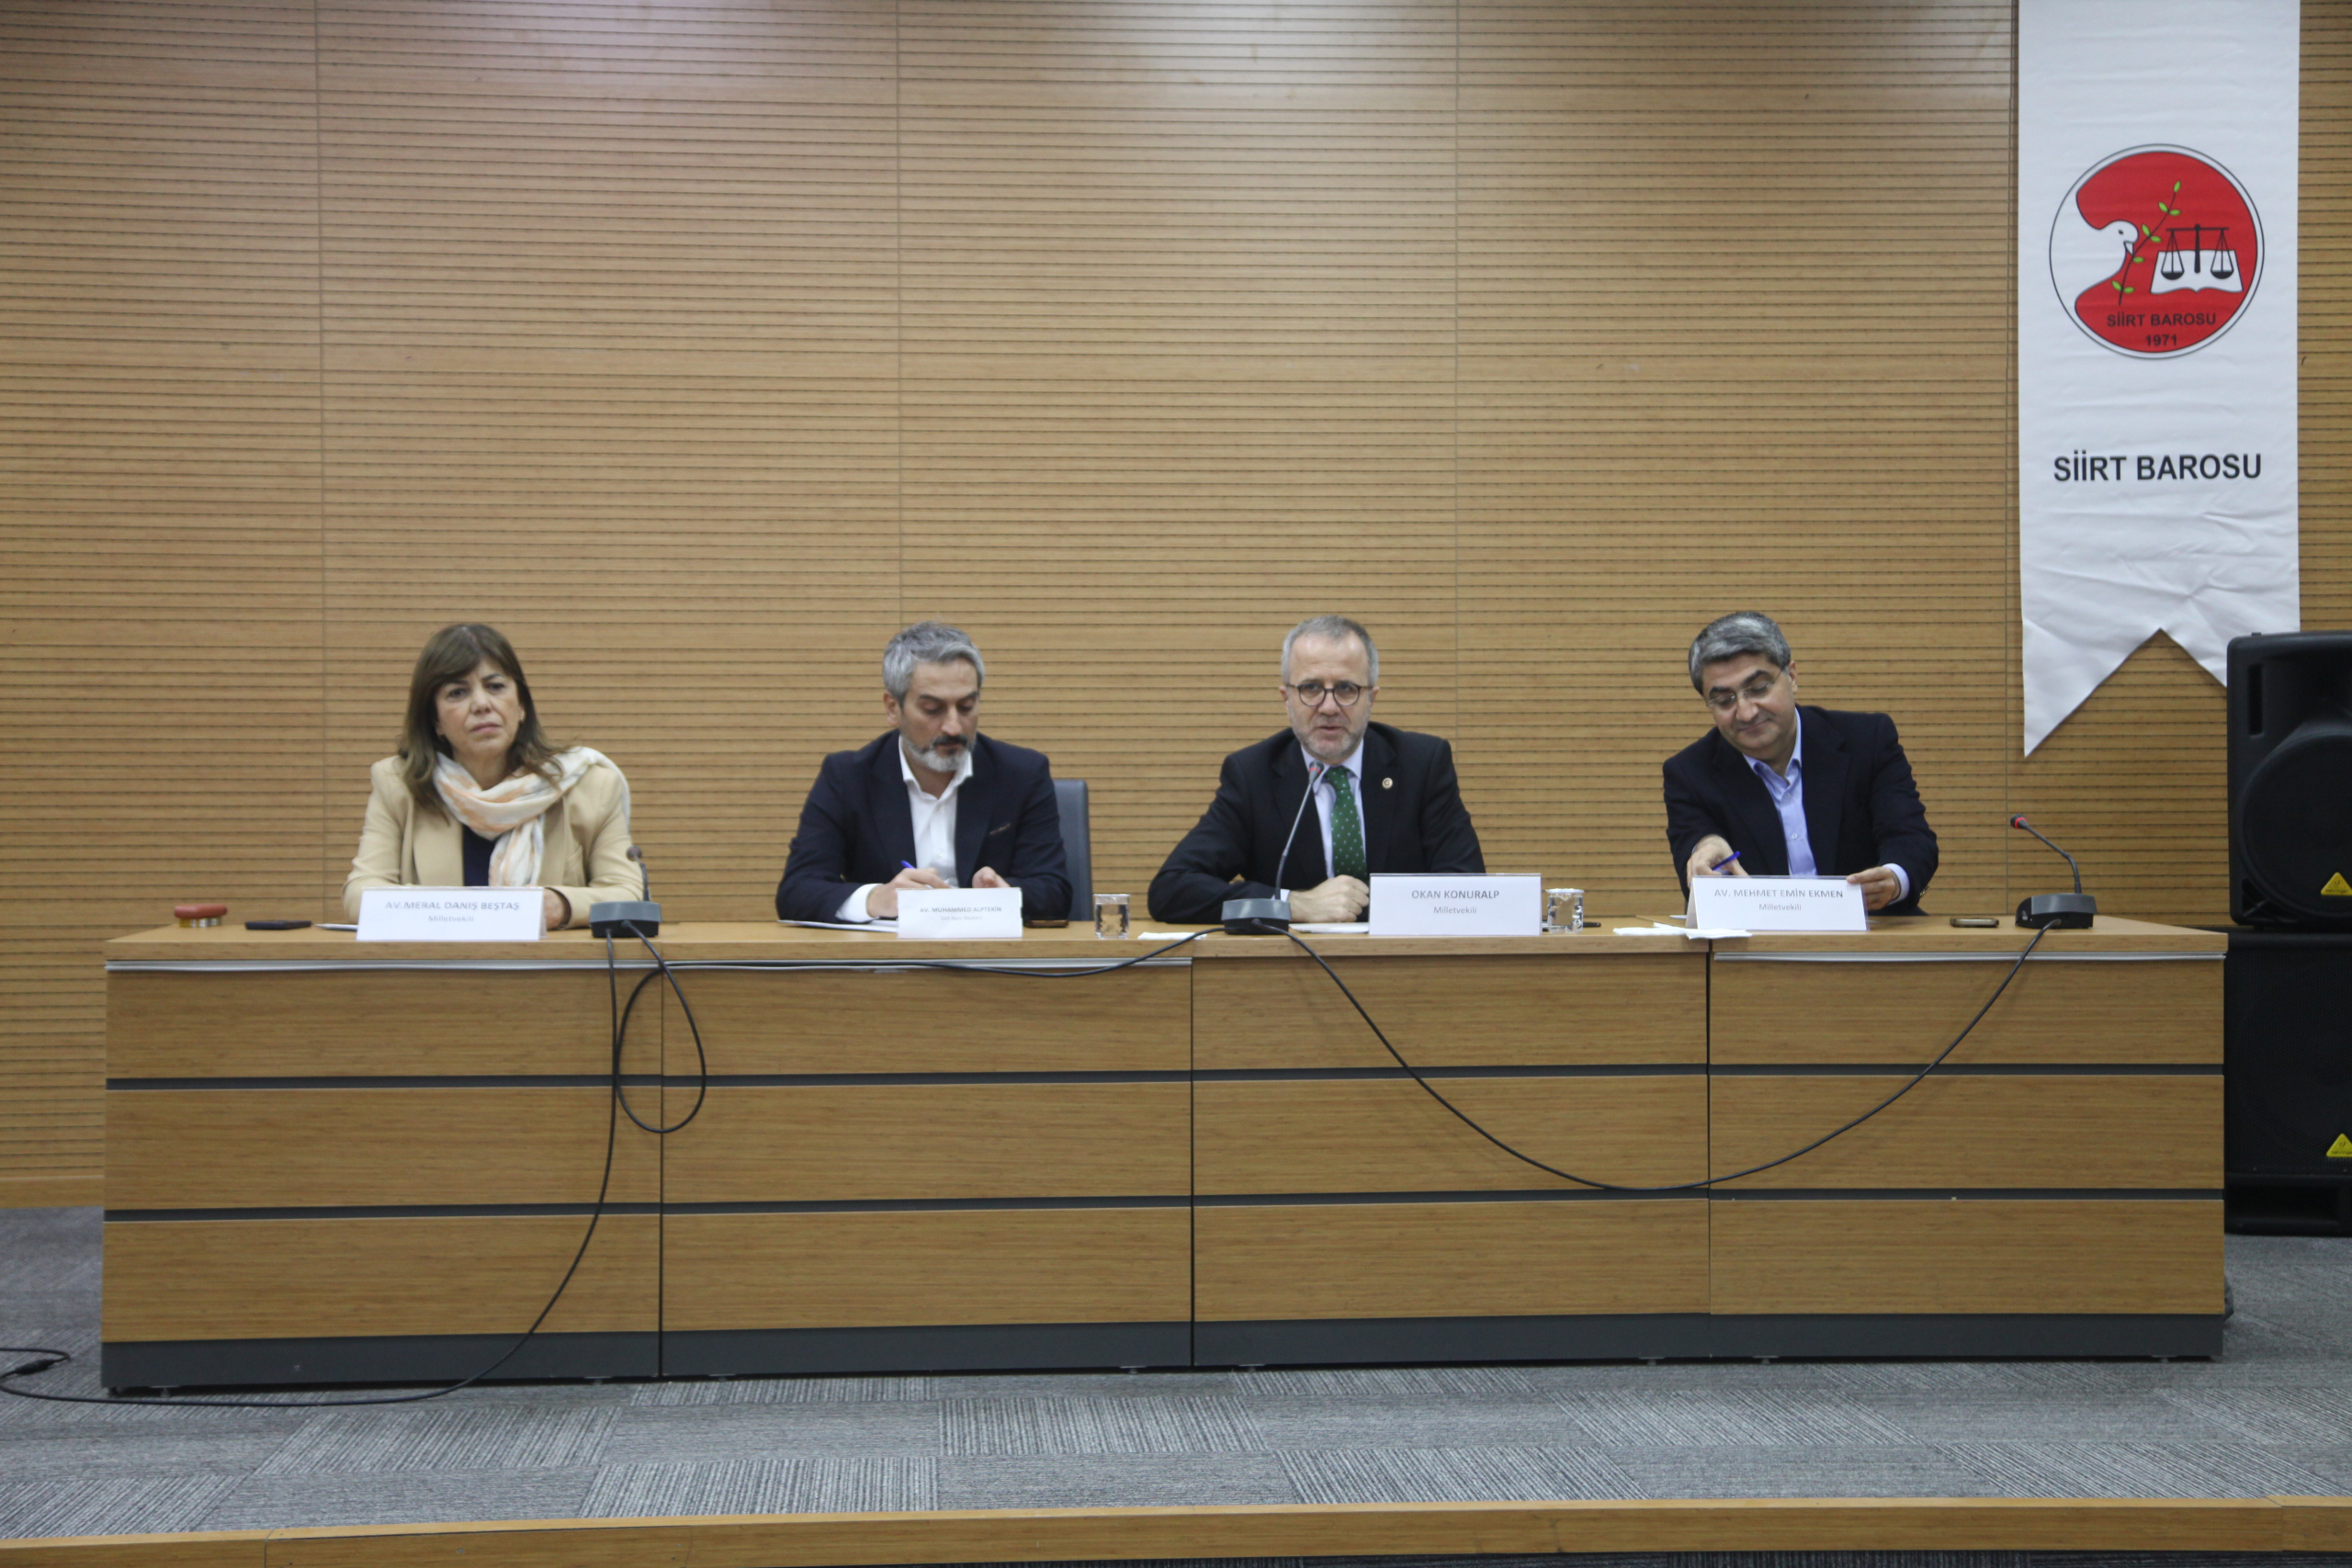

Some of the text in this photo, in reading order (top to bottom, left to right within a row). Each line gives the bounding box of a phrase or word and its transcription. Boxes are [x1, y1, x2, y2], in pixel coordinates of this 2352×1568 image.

[2151, 312, 2216, 326] BAROSU
[2145, 333, 2177, 346] 1971
[2053, 449, 2261, 481] SİİRT BAROSU
[1411, 890, 1499, 899] OKAN KONURALP
[1713, 887, 1844, 898] AV. MEHMET EMİN EKMEN
[444, 901, 478, 910] DANIŞ
[481, 901, 520, 910] BEŞTAŞ
[1433, 906, 1477, 914] Milletvekili
[1758, 903, 1802, 911] Milletvekili
